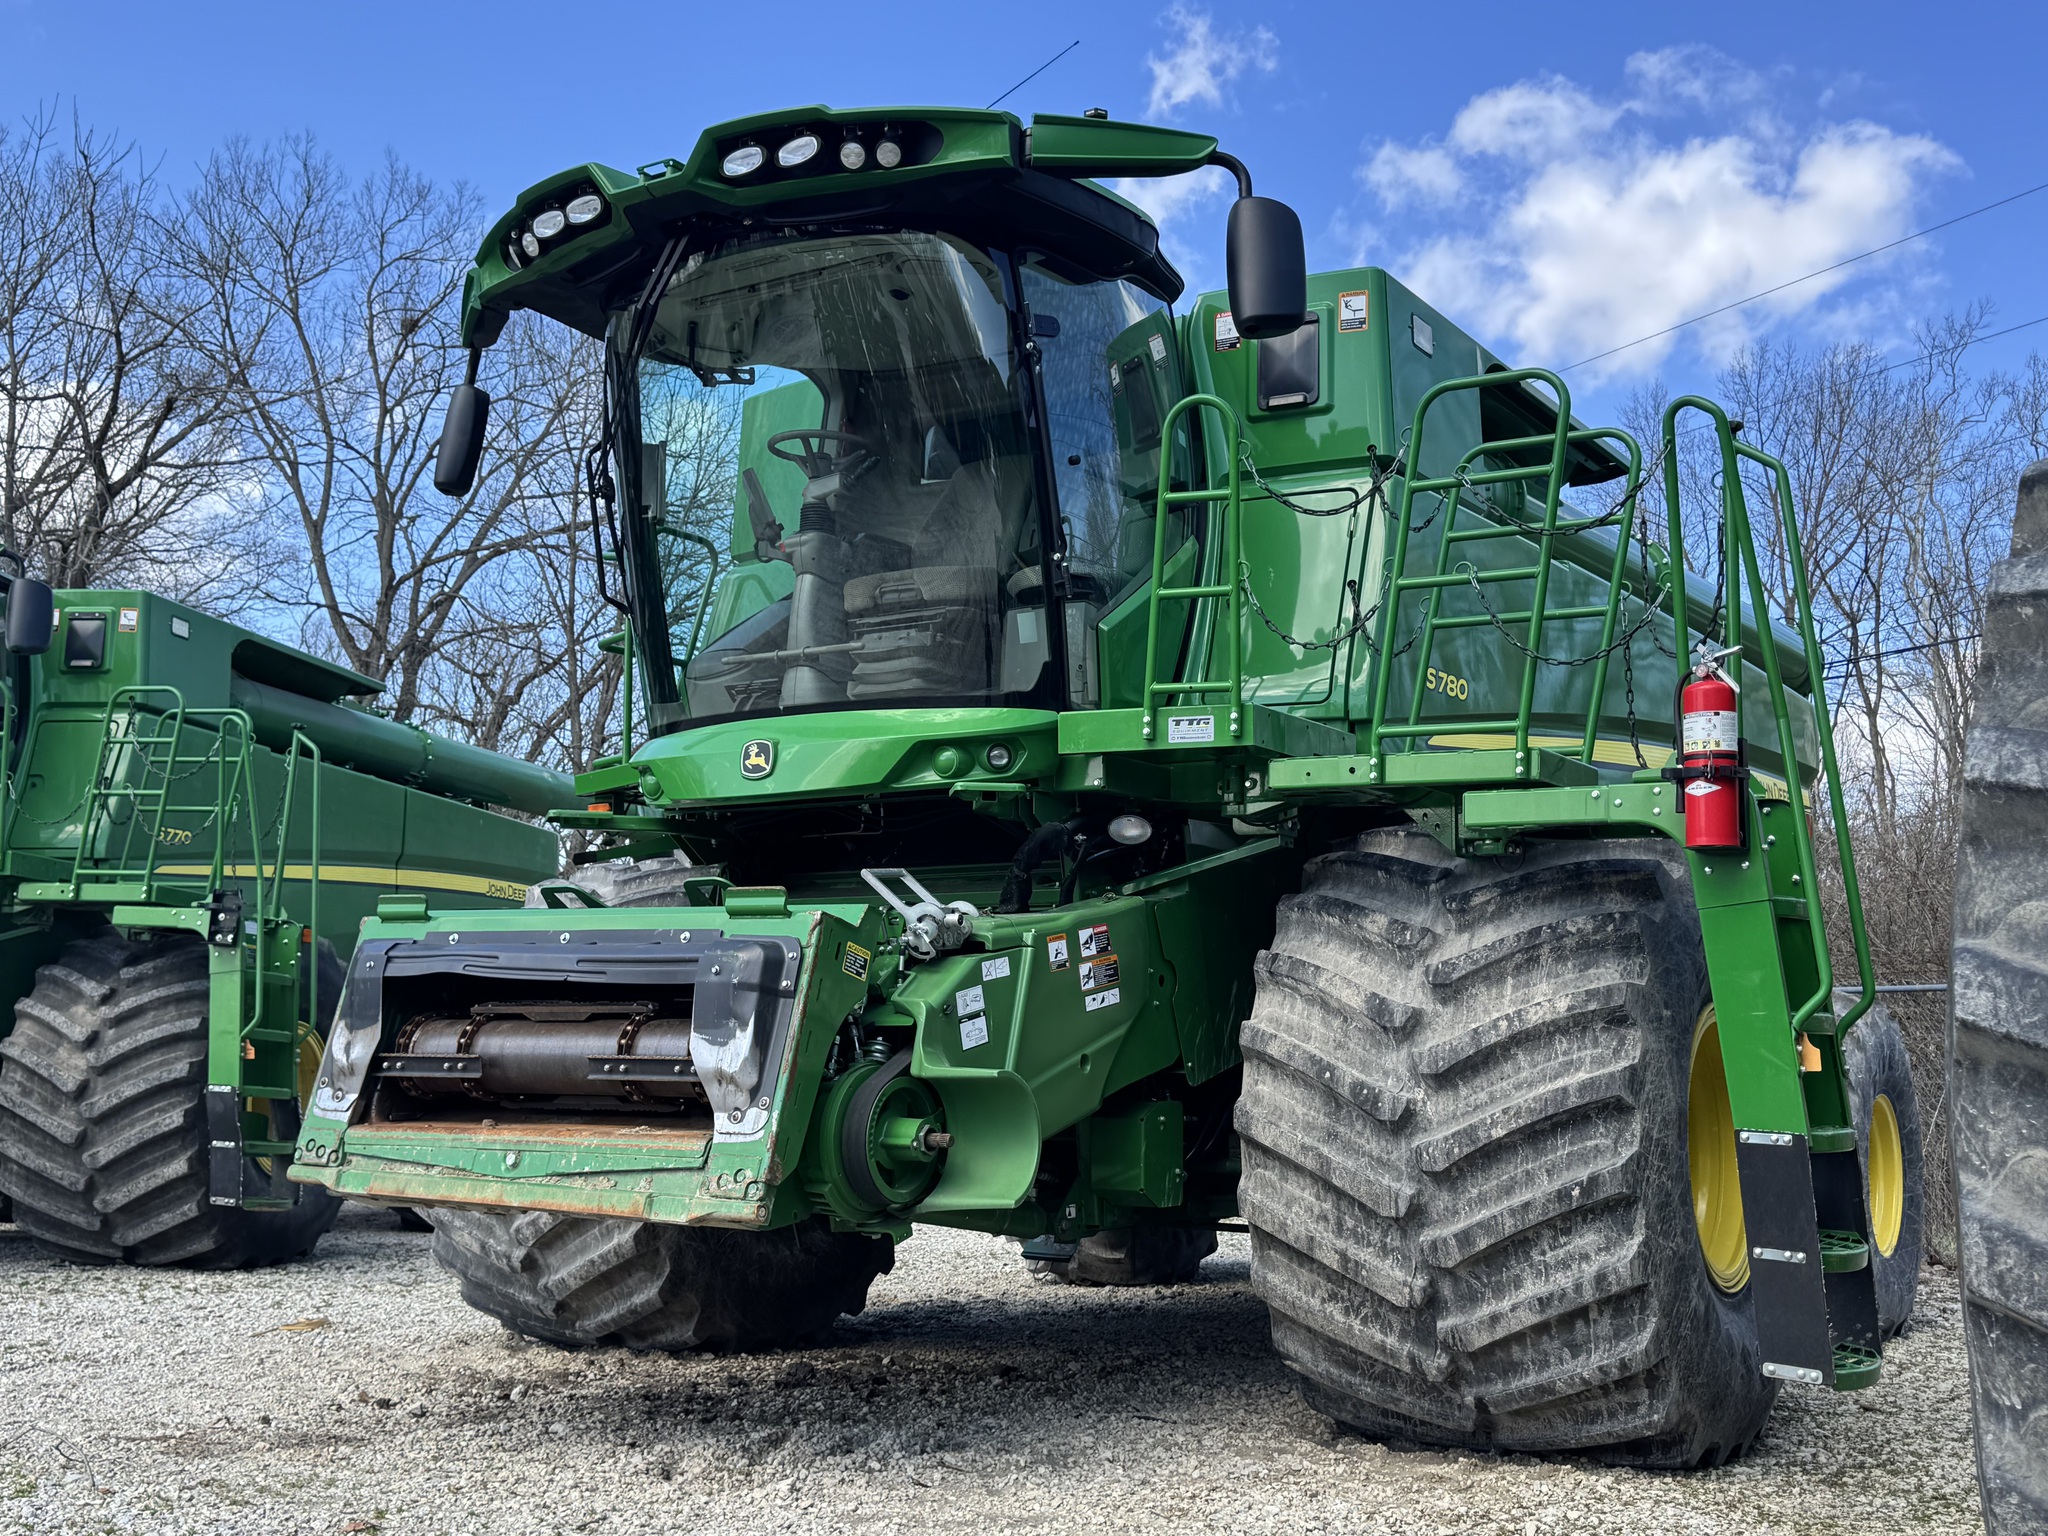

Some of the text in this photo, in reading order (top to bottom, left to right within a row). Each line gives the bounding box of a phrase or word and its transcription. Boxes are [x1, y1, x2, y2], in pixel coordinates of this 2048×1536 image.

[1426, 667, 1468, 701] S780
[1172, 718, 1211, 727] TTG
[486, 881, 526, 900] JOHN DEER
